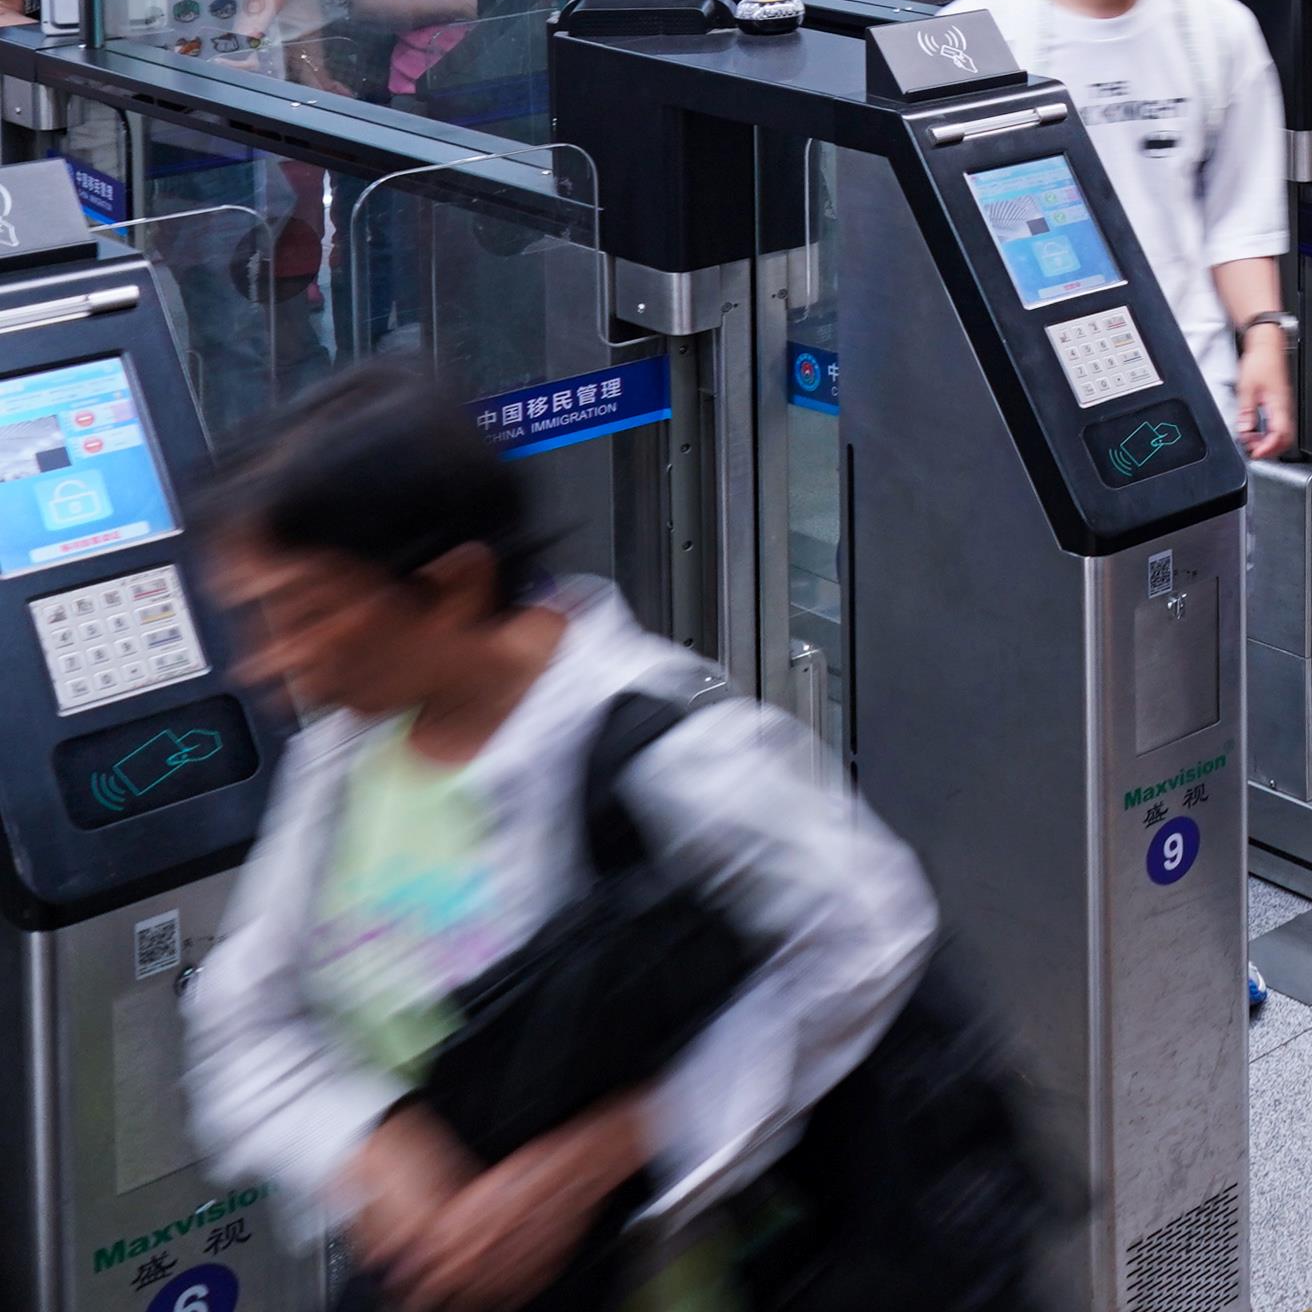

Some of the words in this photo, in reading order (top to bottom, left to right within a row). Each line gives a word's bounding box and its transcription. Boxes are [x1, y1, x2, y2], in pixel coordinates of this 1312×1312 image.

[477, 377, 622, 430] 中国移民管理
[531, 403, 618, 434] IMMIGRATION
[1124, 755, 1227, 811] Maxvision
[1163, 832, 1184, 871] 9
[130, 1217, 252, 1292] 盛视
